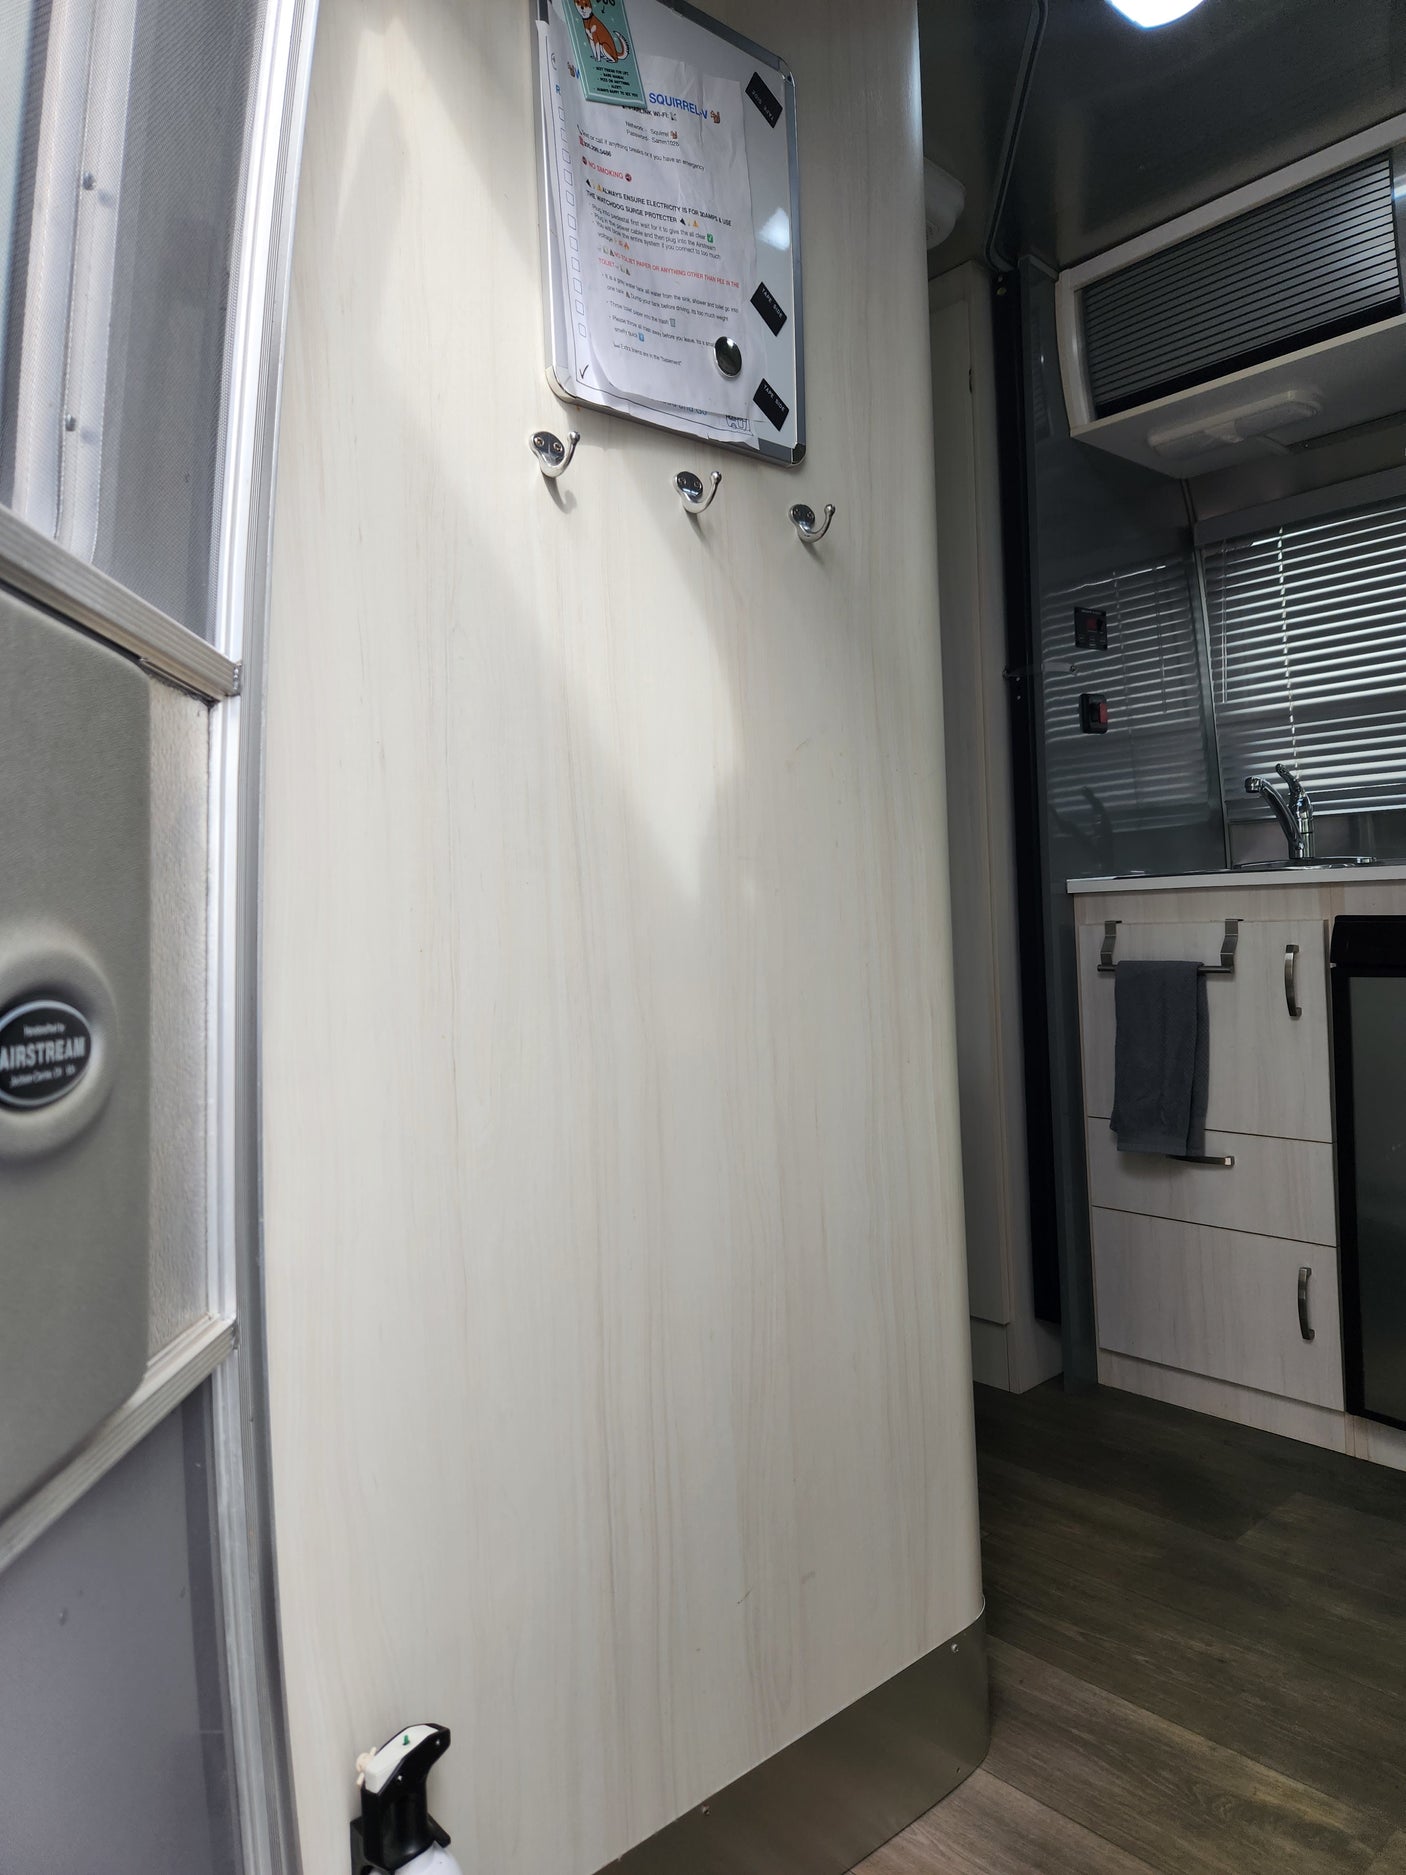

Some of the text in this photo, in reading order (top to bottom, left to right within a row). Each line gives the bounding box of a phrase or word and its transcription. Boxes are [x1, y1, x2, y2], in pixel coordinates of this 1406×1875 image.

[596, 165, 624, 179] SMOKING
[596, 195, 625, 211] WATCHDOG
[625, 205, 644, 217] SURGE
[602, 187, 623, 199] ALWAYS
[623, 193, 646, 205] ENSURE
[646, 199, 681, 212] ELECTRICITY
[0, 1036, 86, 1073] AIRSTREAM
